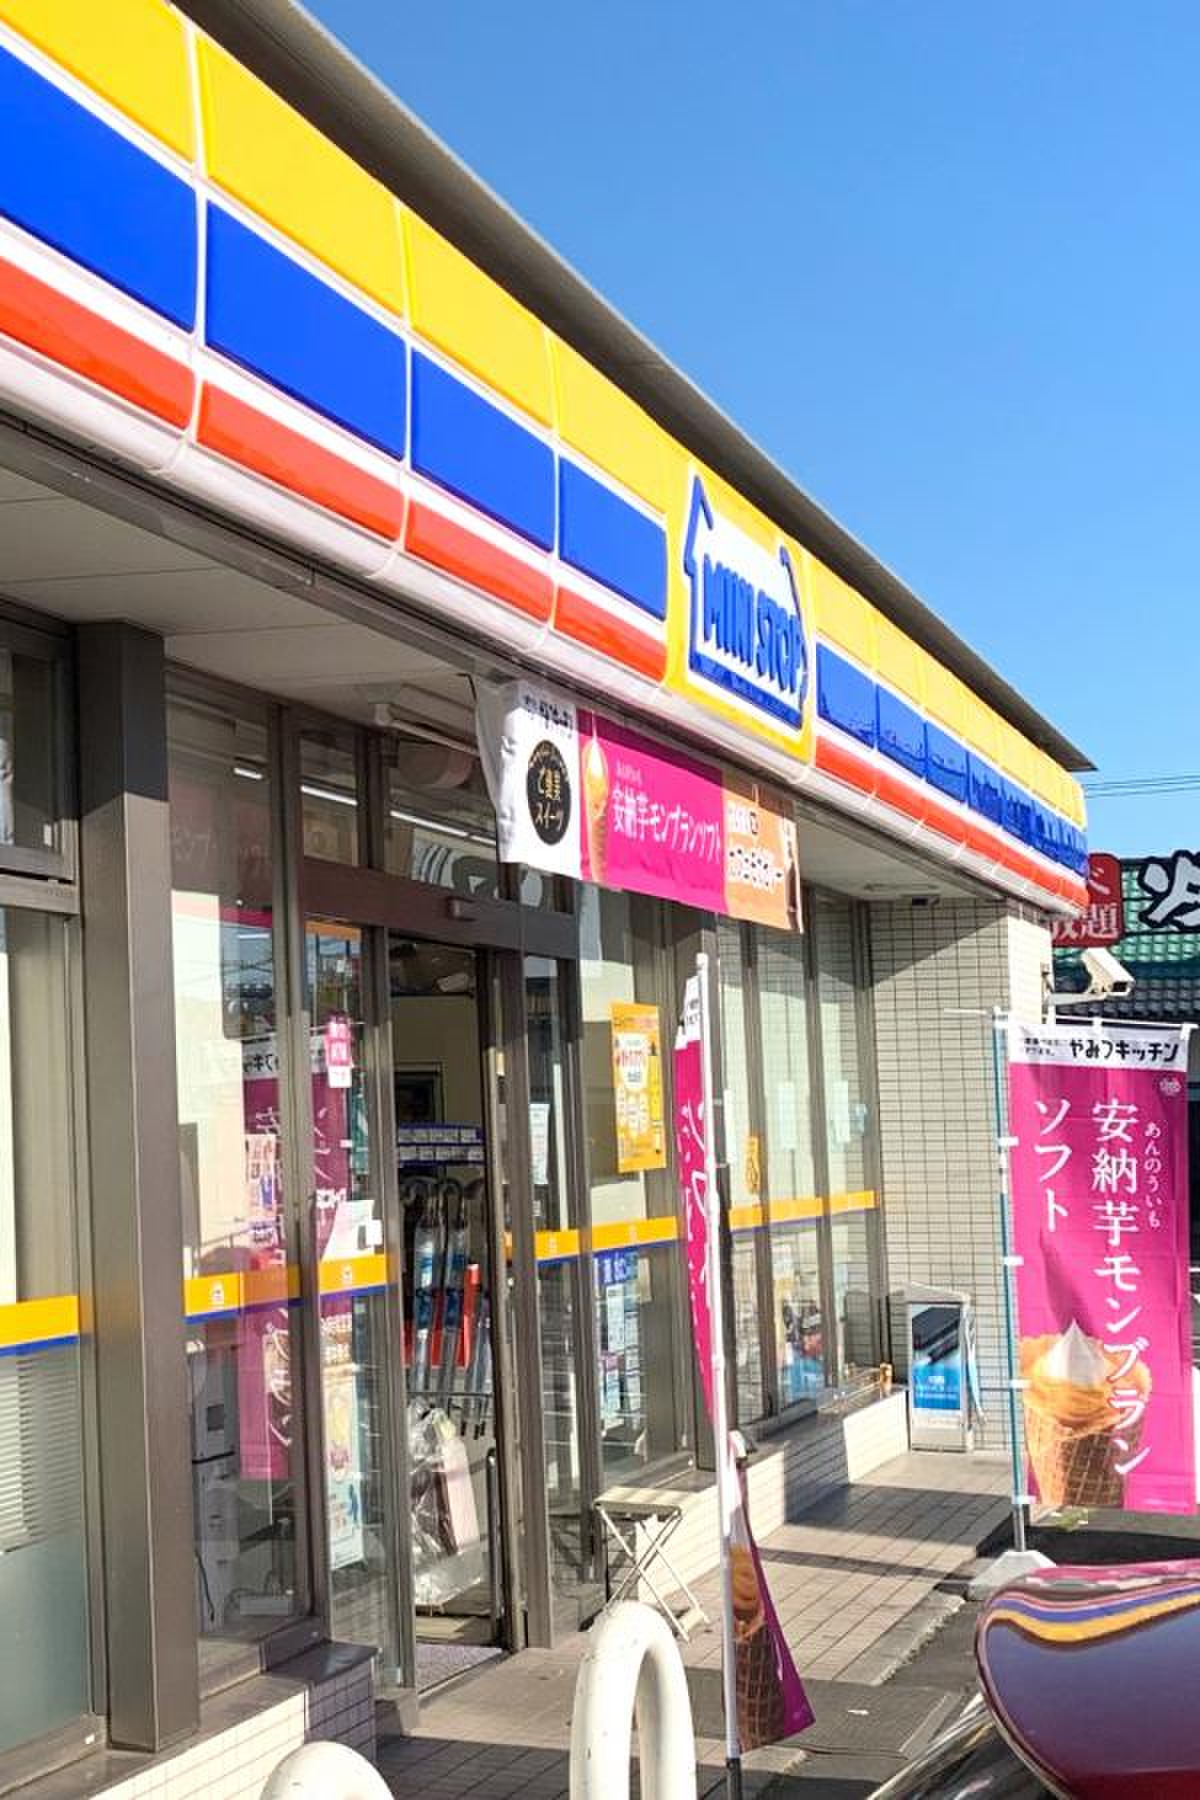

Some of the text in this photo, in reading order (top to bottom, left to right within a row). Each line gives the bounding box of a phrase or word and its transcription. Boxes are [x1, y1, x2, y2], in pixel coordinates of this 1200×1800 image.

[703, 553, 802, 694] MINI STOP
[1069, 1038, 1180, 1064] やみつキッチン
[1034, 1099, 1073, 1233] ソフト
[1144, 1121, 1162, 1229] あんのういも
[1092, 1098, 1151, 1476] 安納芋モンブラン
